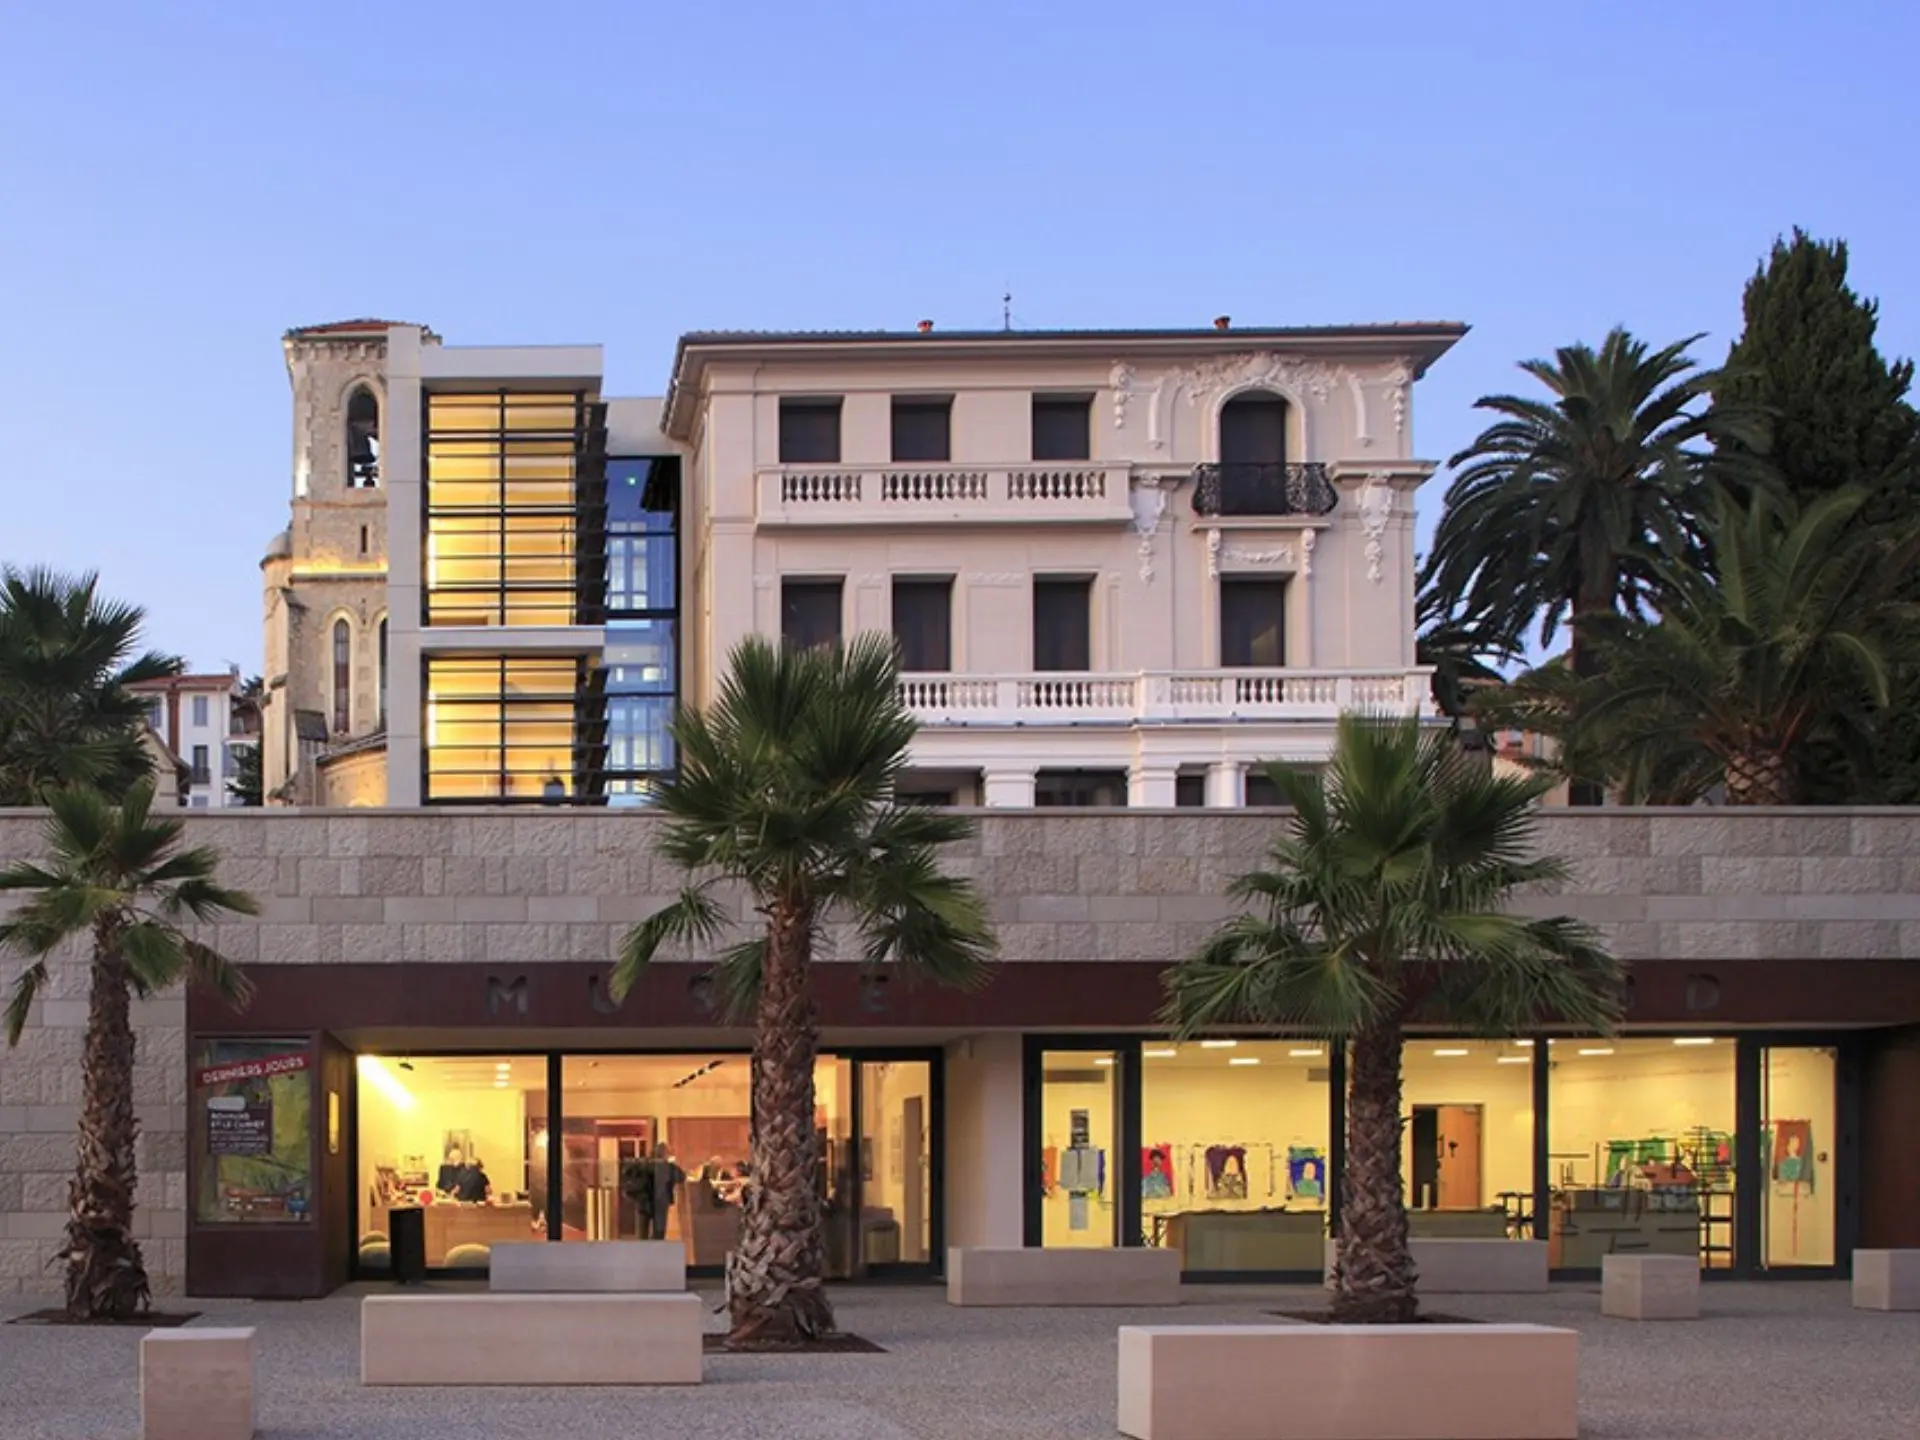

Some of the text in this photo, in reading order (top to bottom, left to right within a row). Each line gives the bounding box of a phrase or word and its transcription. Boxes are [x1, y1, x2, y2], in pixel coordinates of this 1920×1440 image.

[487, 974, 889, 1015] MUSE
[202, 1057, 304, 1083] DERNIERS JOURS
